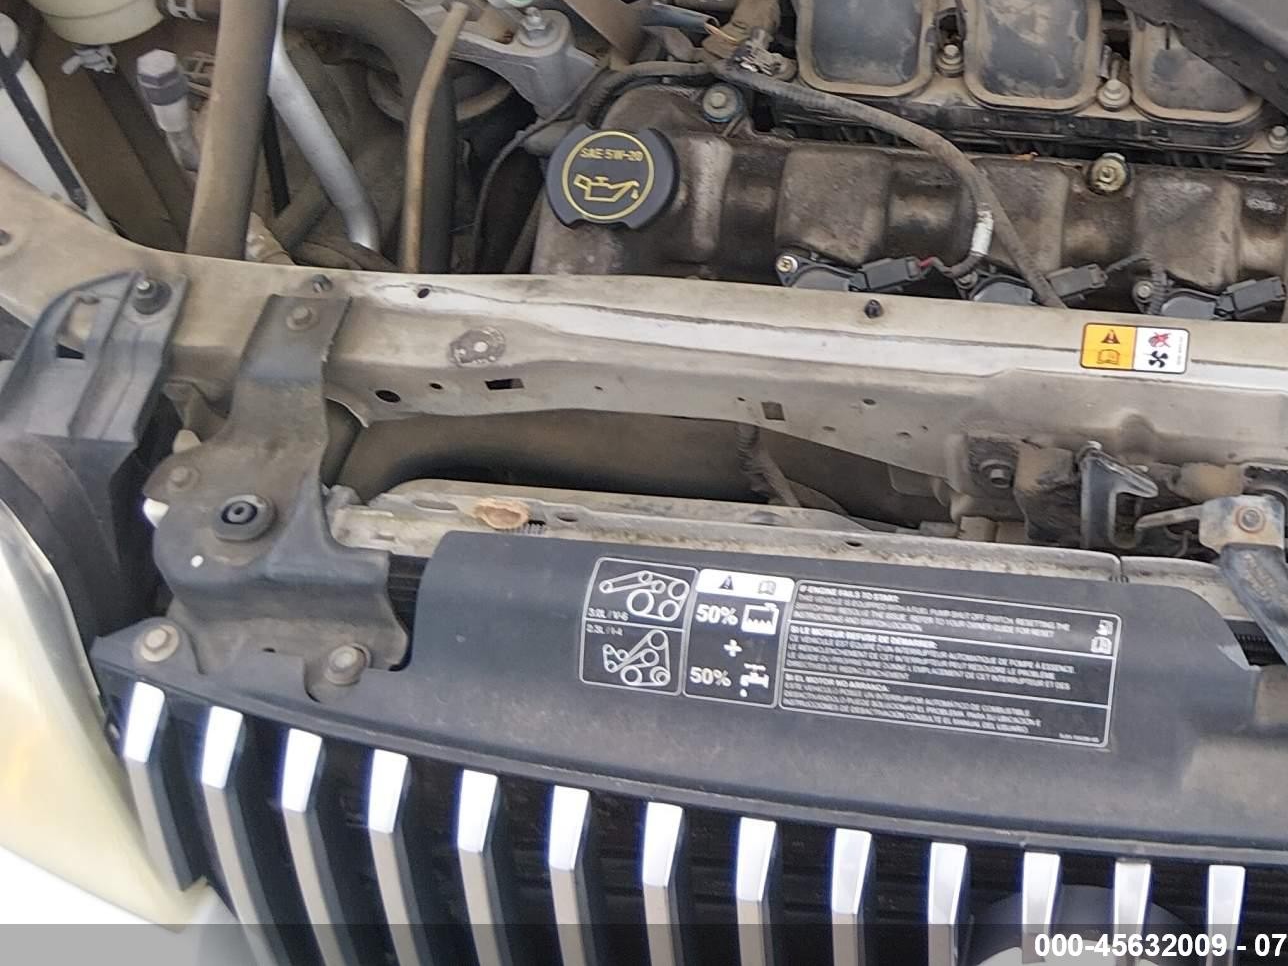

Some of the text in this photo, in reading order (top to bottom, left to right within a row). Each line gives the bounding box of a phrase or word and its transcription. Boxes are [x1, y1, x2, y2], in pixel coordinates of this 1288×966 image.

[580, 147, 644, 162] SAE 5W-20
[695, 603, 739, 626] 50%
[689, 666, 732, 688] 50%
